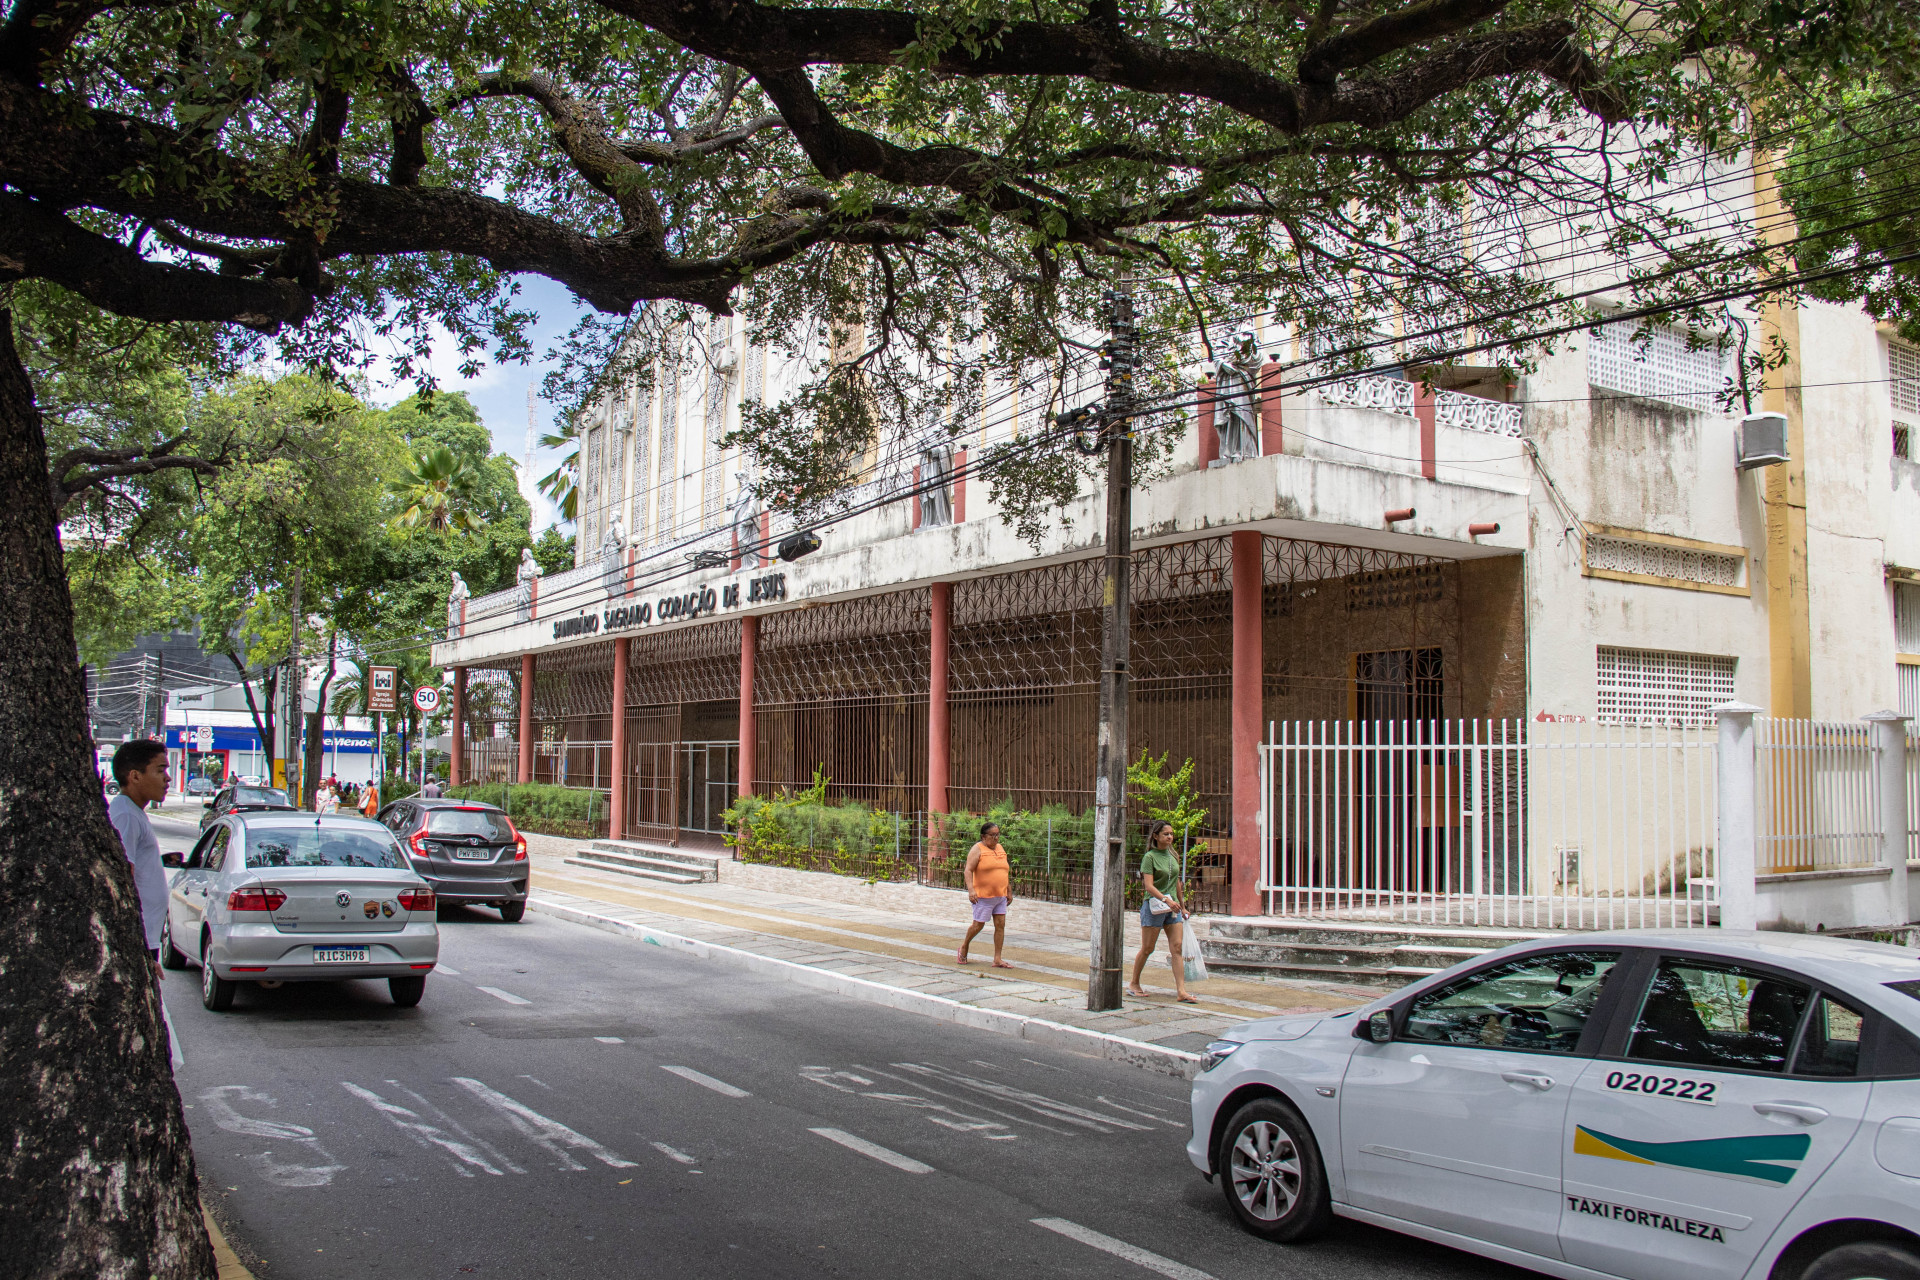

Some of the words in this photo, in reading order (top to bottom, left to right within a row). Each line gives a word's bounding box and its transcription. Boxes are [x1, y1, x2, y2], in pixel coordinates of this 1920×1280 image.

[553, 610, 599, 639] SANTUÁRIO
[604, 602, 651, 630] SAGRADO
[658, 584, 717, 619] CORAÇÃO
[723, 583, 739, 608] DE
[747, 573, 786, 602] JESUS
[418, 691, 436, 703] 50
[319, 950, 365, 961] RIC3H98
[1606, 1071, 1716, 1101] 020222
[1613, 1205, 1725, 1243] FORTALEZA
